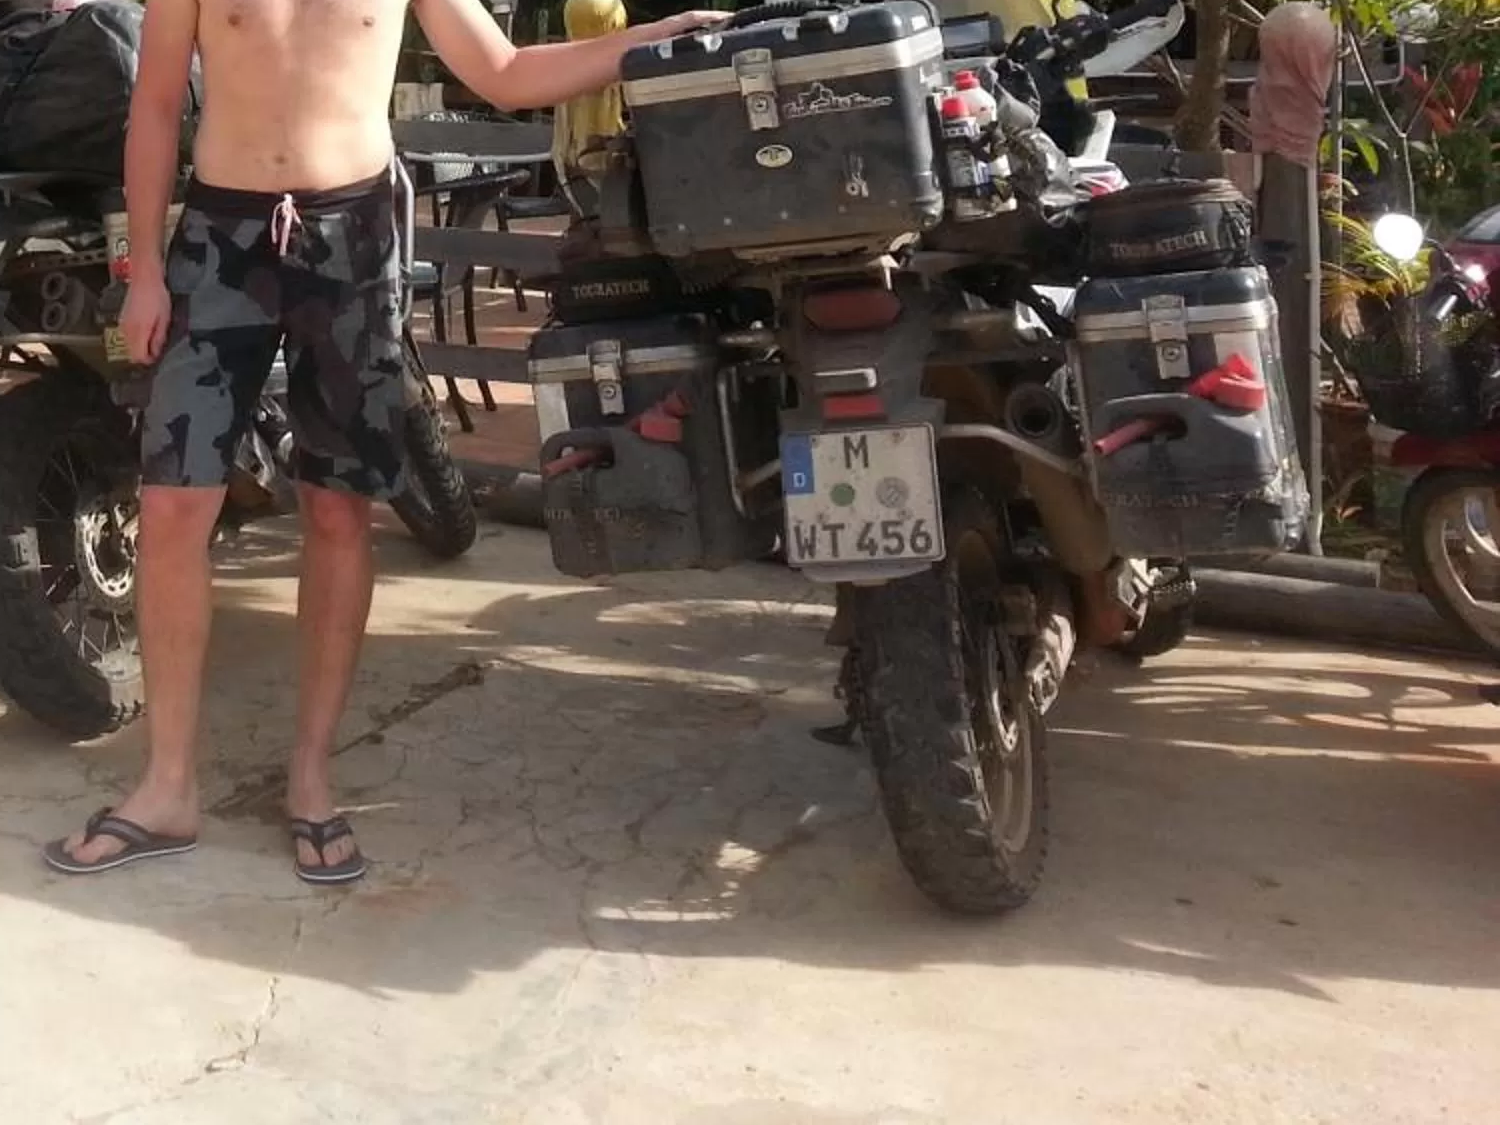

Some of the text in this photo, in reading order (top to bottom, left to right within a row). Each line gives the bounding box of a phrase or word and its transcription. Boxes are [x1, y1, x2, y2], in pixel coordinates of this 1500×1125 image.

[843, 434, 870, 470] M
[792, 471, 807, 488] D
[793, 518, 933, 560] WT 456
